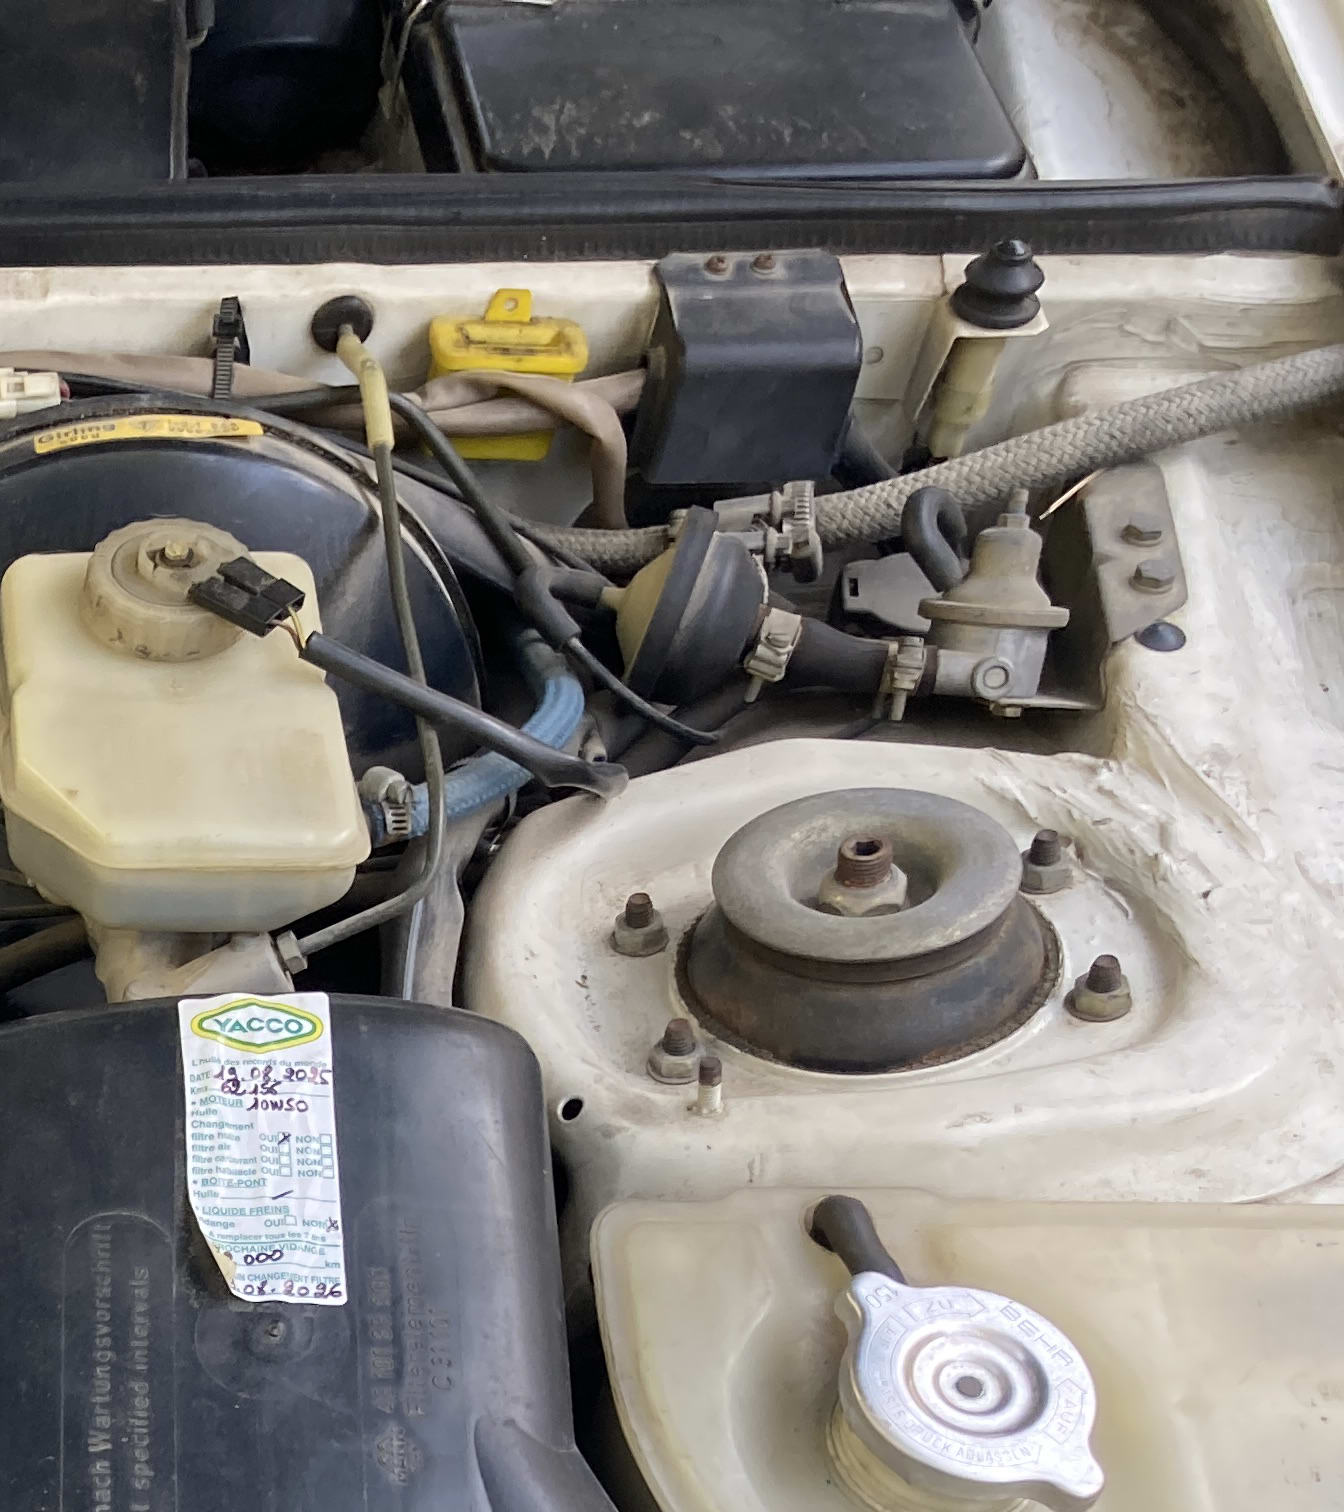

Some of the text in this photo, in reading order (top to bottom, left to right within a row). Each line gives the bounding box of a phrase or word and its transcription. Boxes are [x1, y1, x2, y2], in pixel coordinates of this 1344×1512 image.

[213, 1017, 303, 1034] YACCO
[199, 1095, 243, 1107] MOTEUR
[191, 1132, 214, 1141] filtre
[259, 1133, 278, 1143] OUI
[296, 1135, 320, 1143] NON
[191, 1143, 215, 1152] filtre
[260, 1144, 279, 1154] OUI
[192, 1155, 213, 1164] filtre
[260, 1155, 279, 1165] OUI
[297, 1158, 321, 1166] NON
[192, 1166, 213, 1175] filtre
[261, 1167, 279, 1176] OUI
[202, 1205, 289, 1216] LIQUIDE FREINS
[264, 1217, 284, 1227] OUI
[325, 1261, 340, 1269] km
[1001, 1304, 1074, 1367] BEHR
[1056, 1401, 1077, 1435] AUF
[127, 1382, 157, 1490] specified
